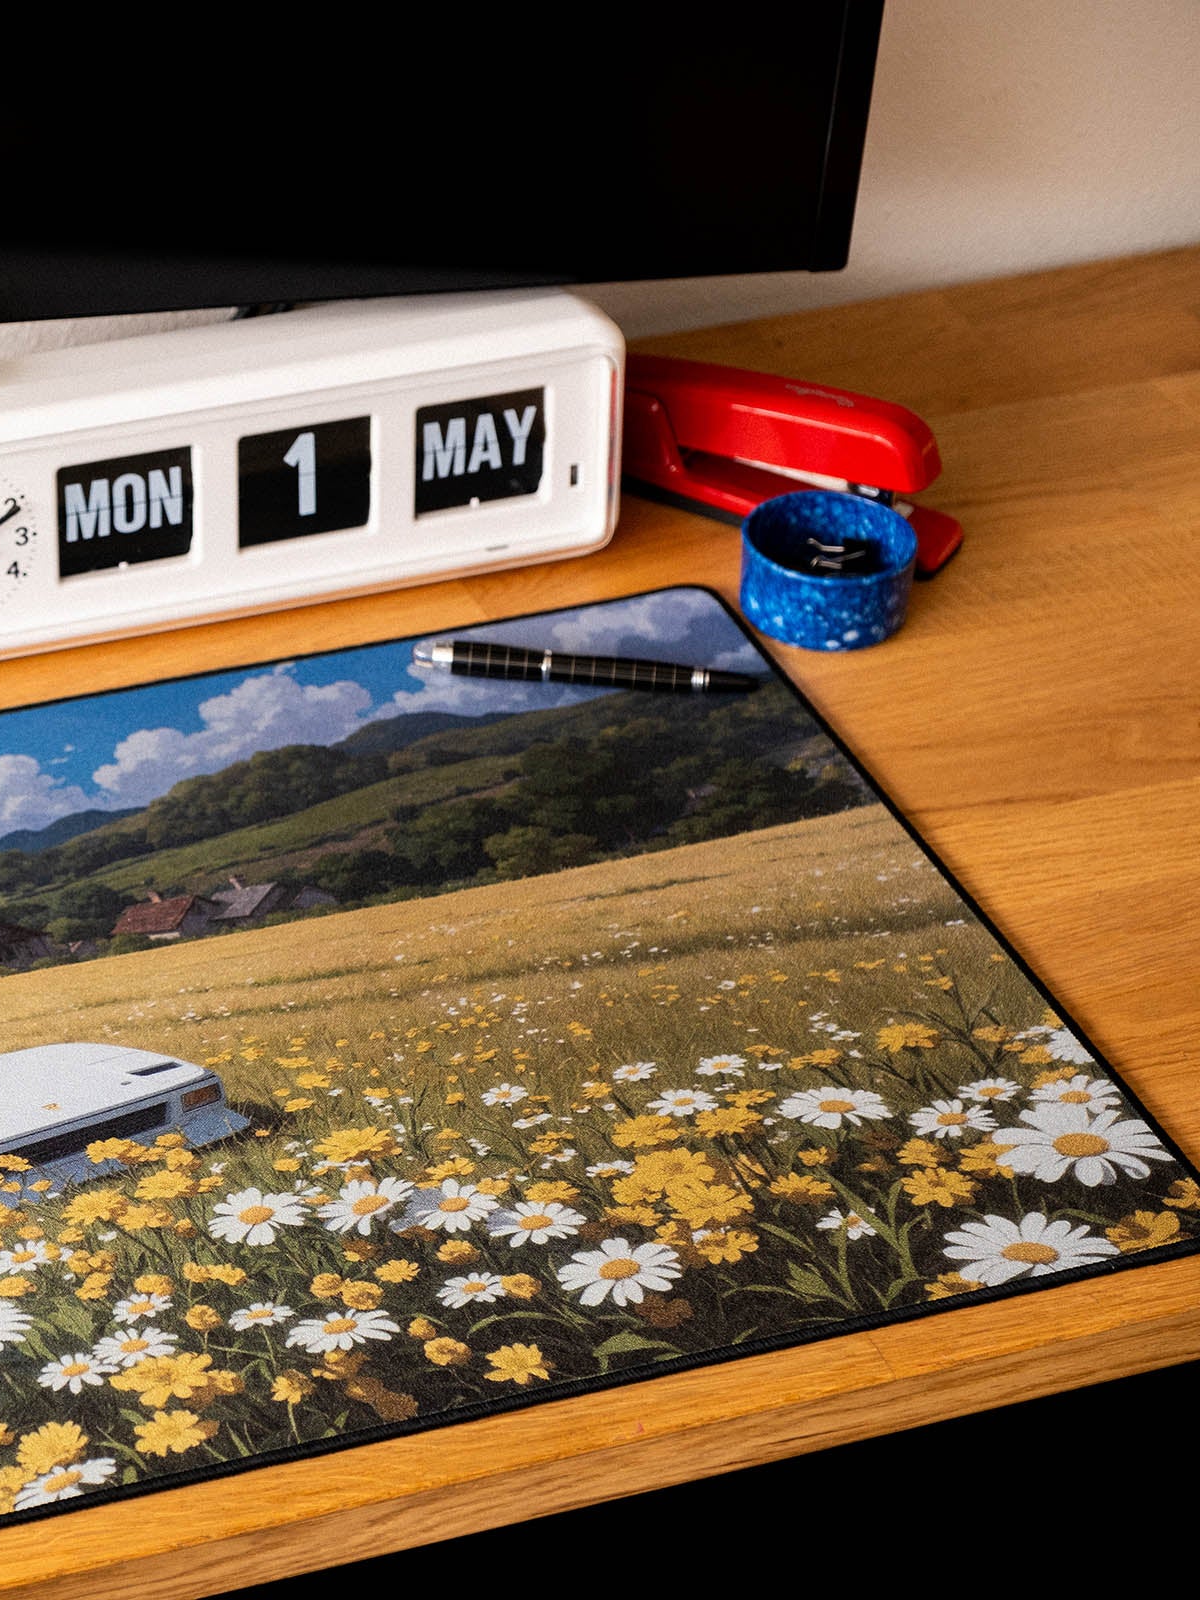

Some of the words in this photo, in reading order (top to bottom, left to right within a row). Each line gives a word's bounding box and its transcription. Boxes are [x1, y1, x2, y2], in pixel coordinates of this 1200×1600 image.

[65, 467, 183, 543] MON
[283, 432, 317, 517] 1
[422, 406, 538, 482] MAY
[4, 497, 19, 514] 2
[15, 527, 29, 546] 3
[6, 561, 20, 578] 4
